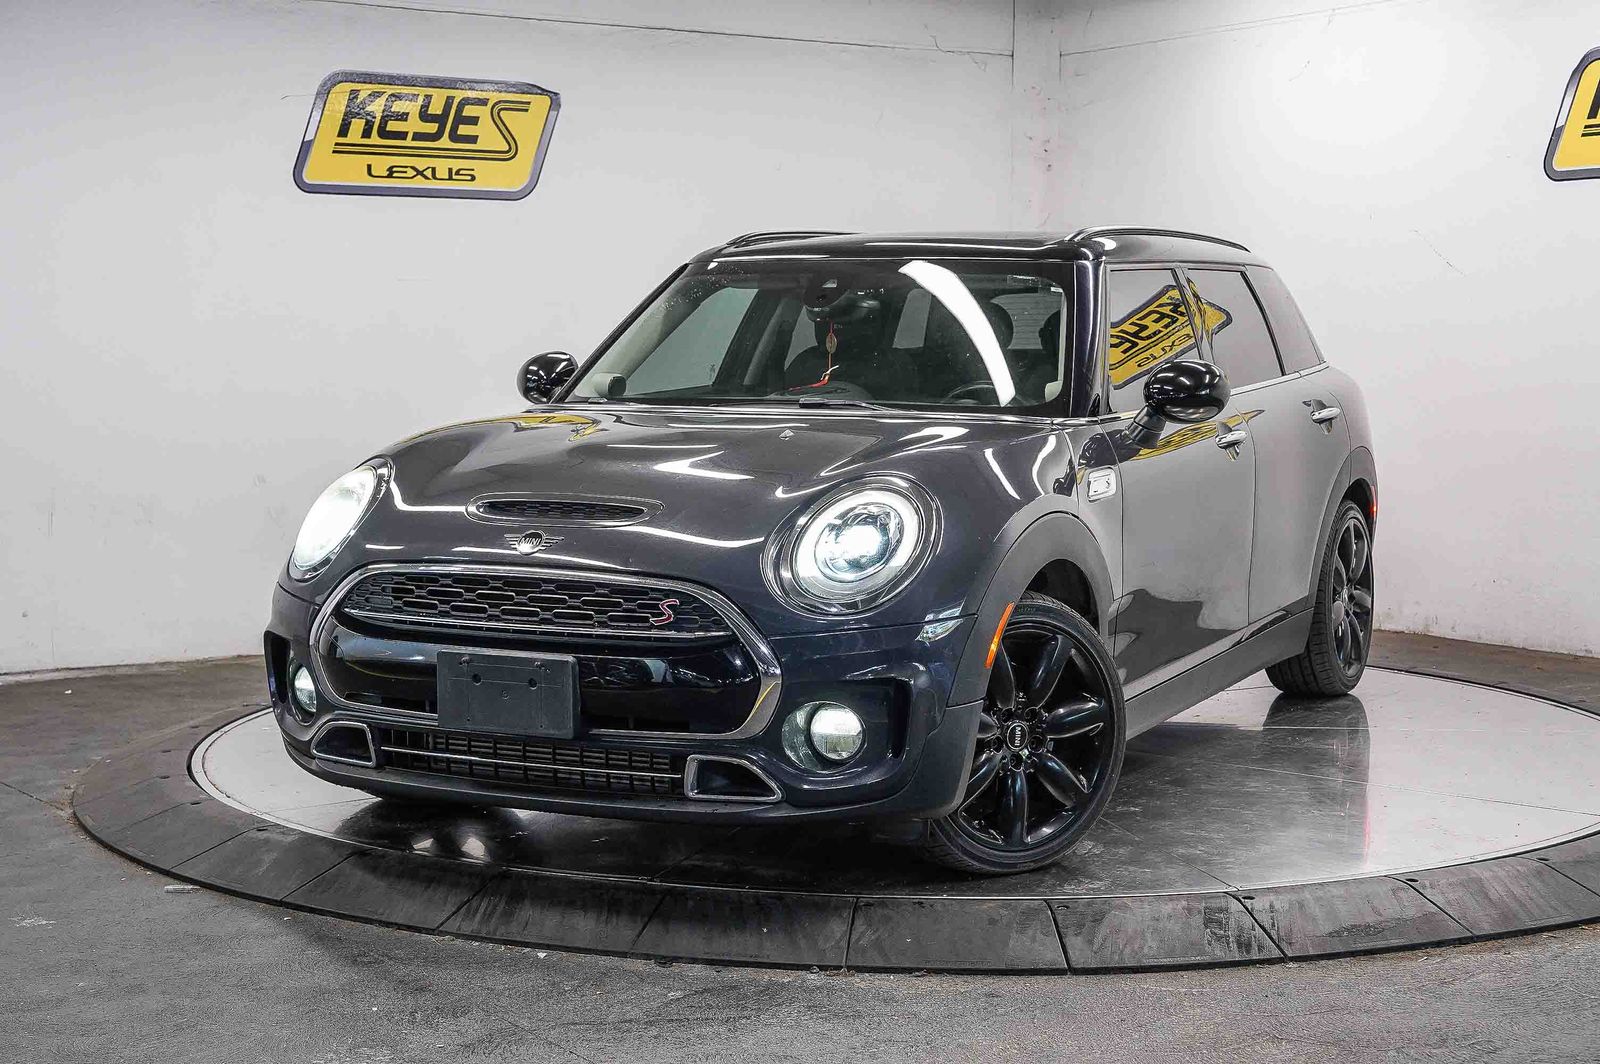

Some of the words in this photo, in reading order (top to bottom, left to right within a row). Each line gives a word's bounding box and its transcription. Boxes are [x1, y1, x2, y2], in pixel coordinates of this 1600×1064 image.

[332, 89, 531, 161] KEYES
[366, 164, 476, 181] LEXUS
[520, 537, 542, 546] MINI
[650, 599, 680, 626] S
[1014, 726, 1022, 746] MINI
